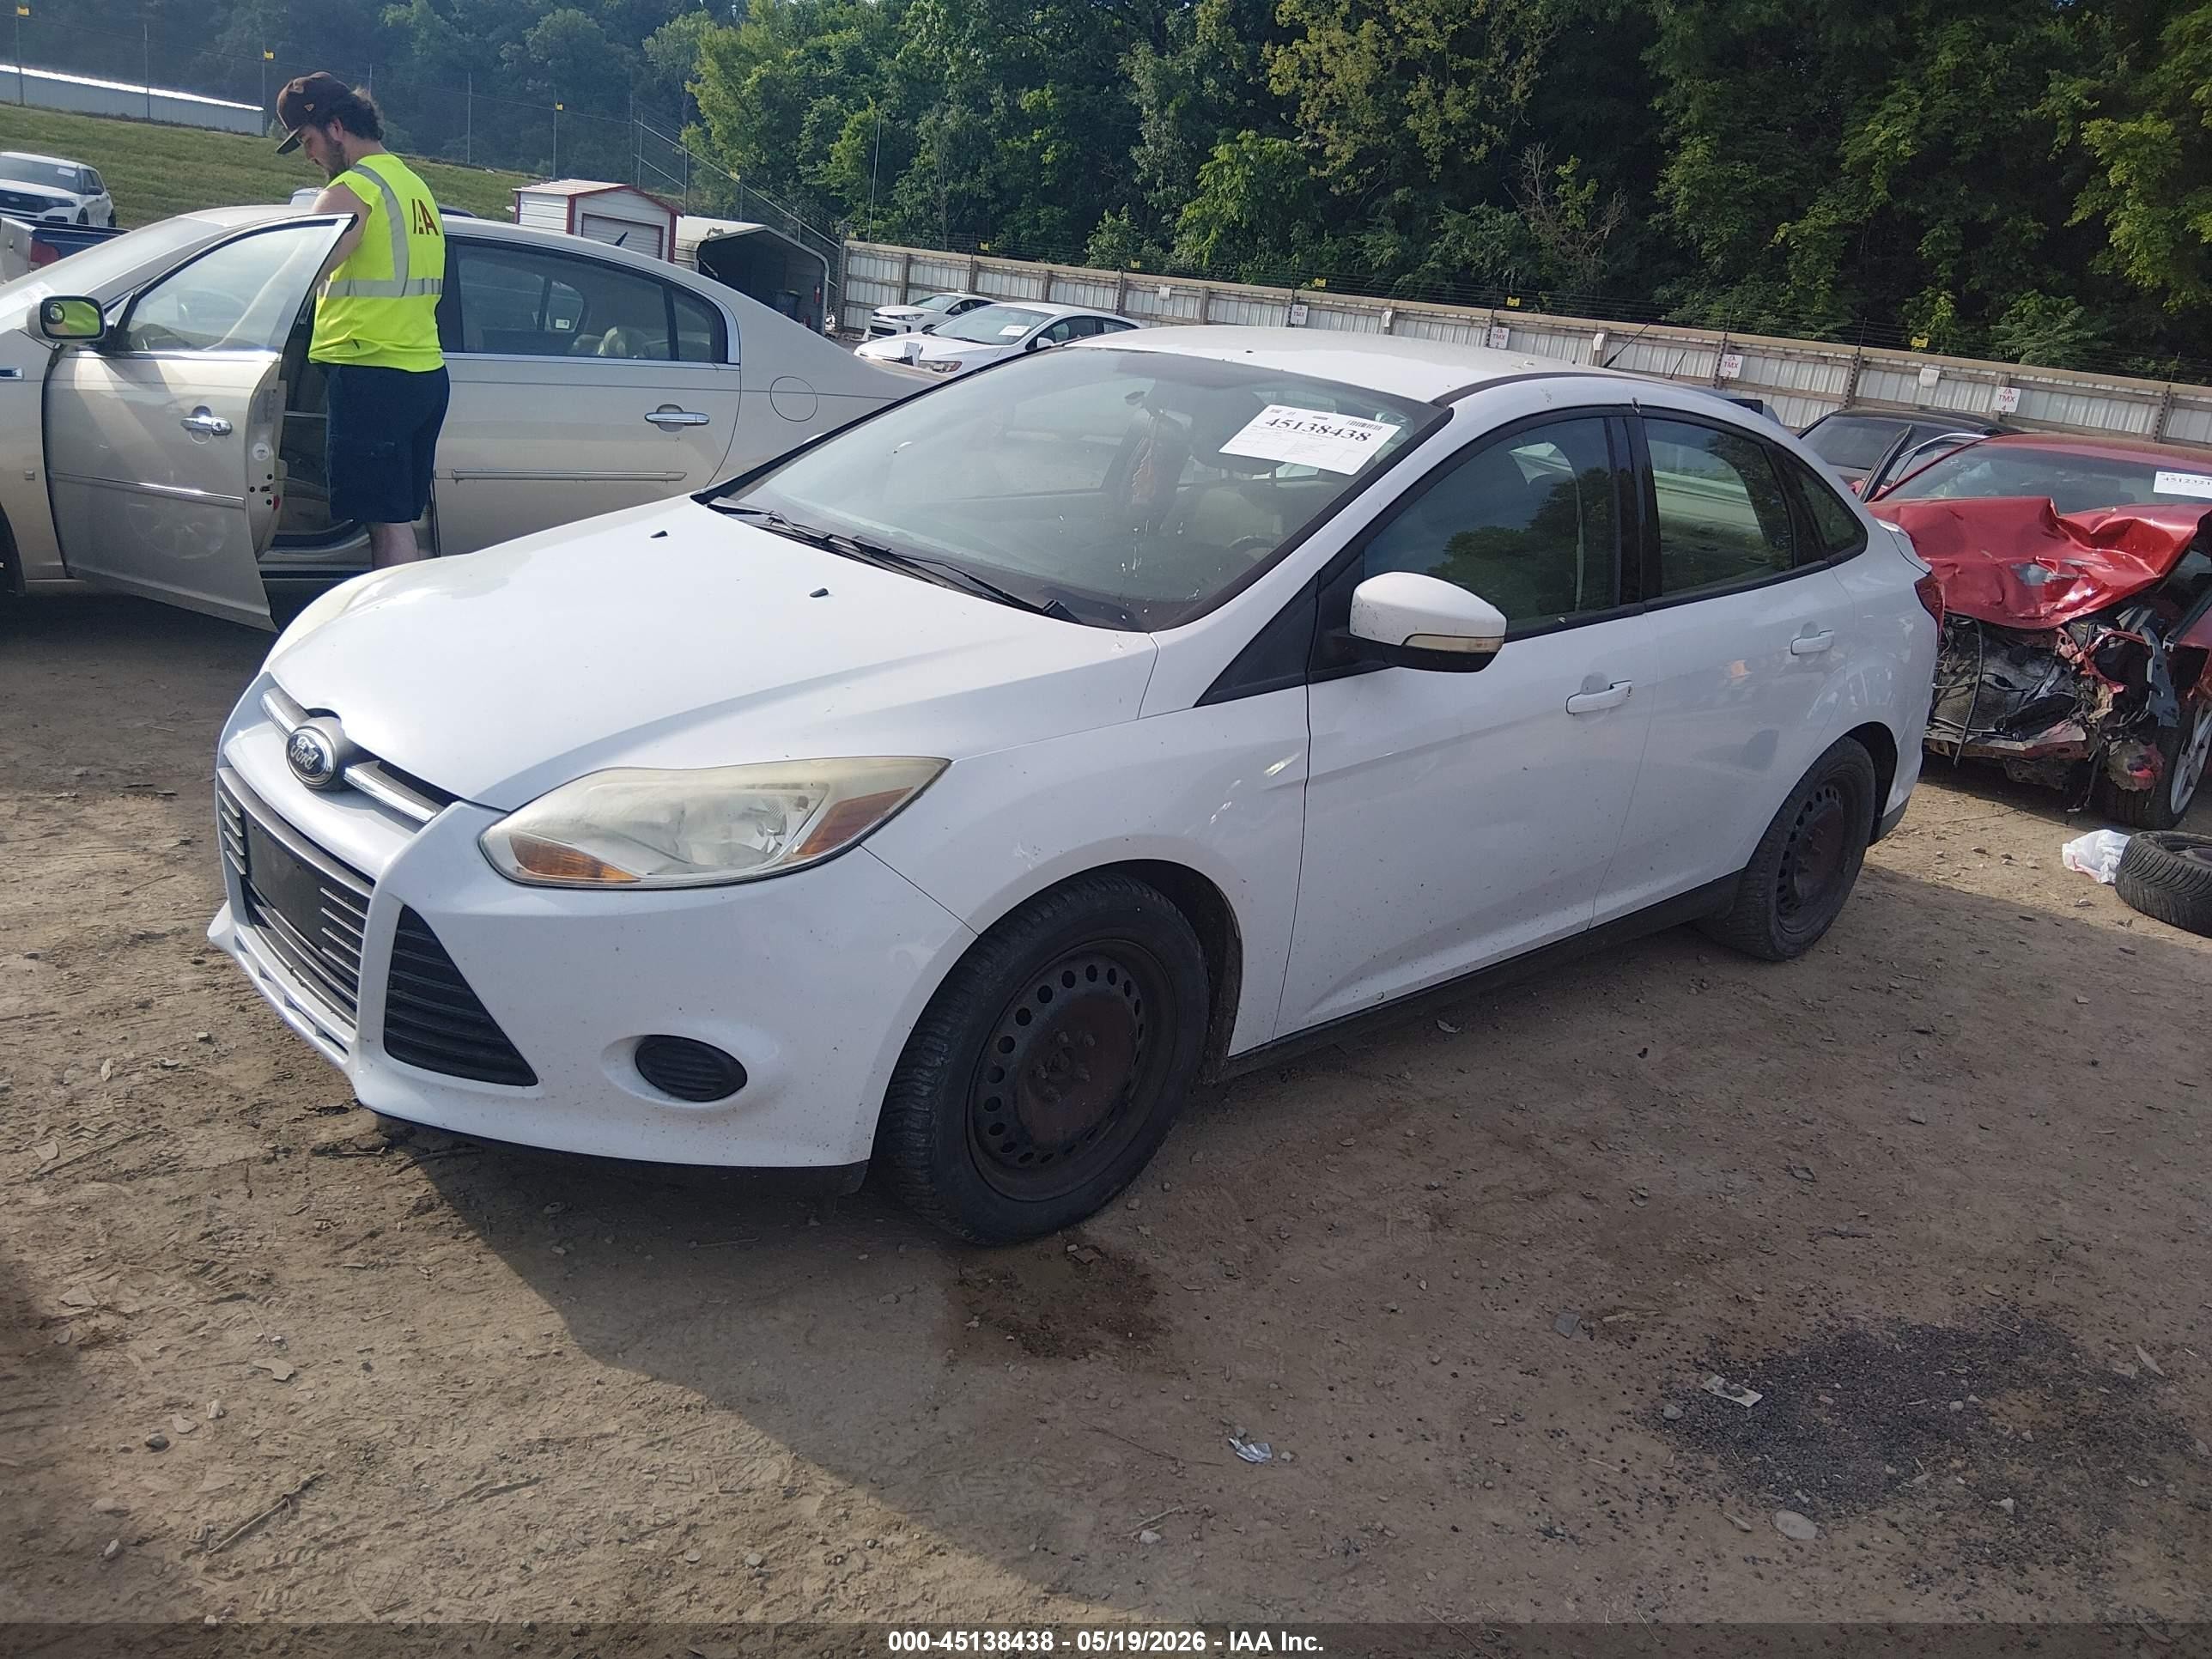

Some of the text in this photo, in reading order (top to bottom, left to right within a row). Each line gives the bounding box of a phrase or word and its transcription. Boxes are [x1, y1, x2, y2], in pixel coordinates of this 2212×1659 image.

[1998, 394, 2015, 403] TMX
[1264, 417, 1372, 442] 45138438
[291, 736, 319, 770] Ford
